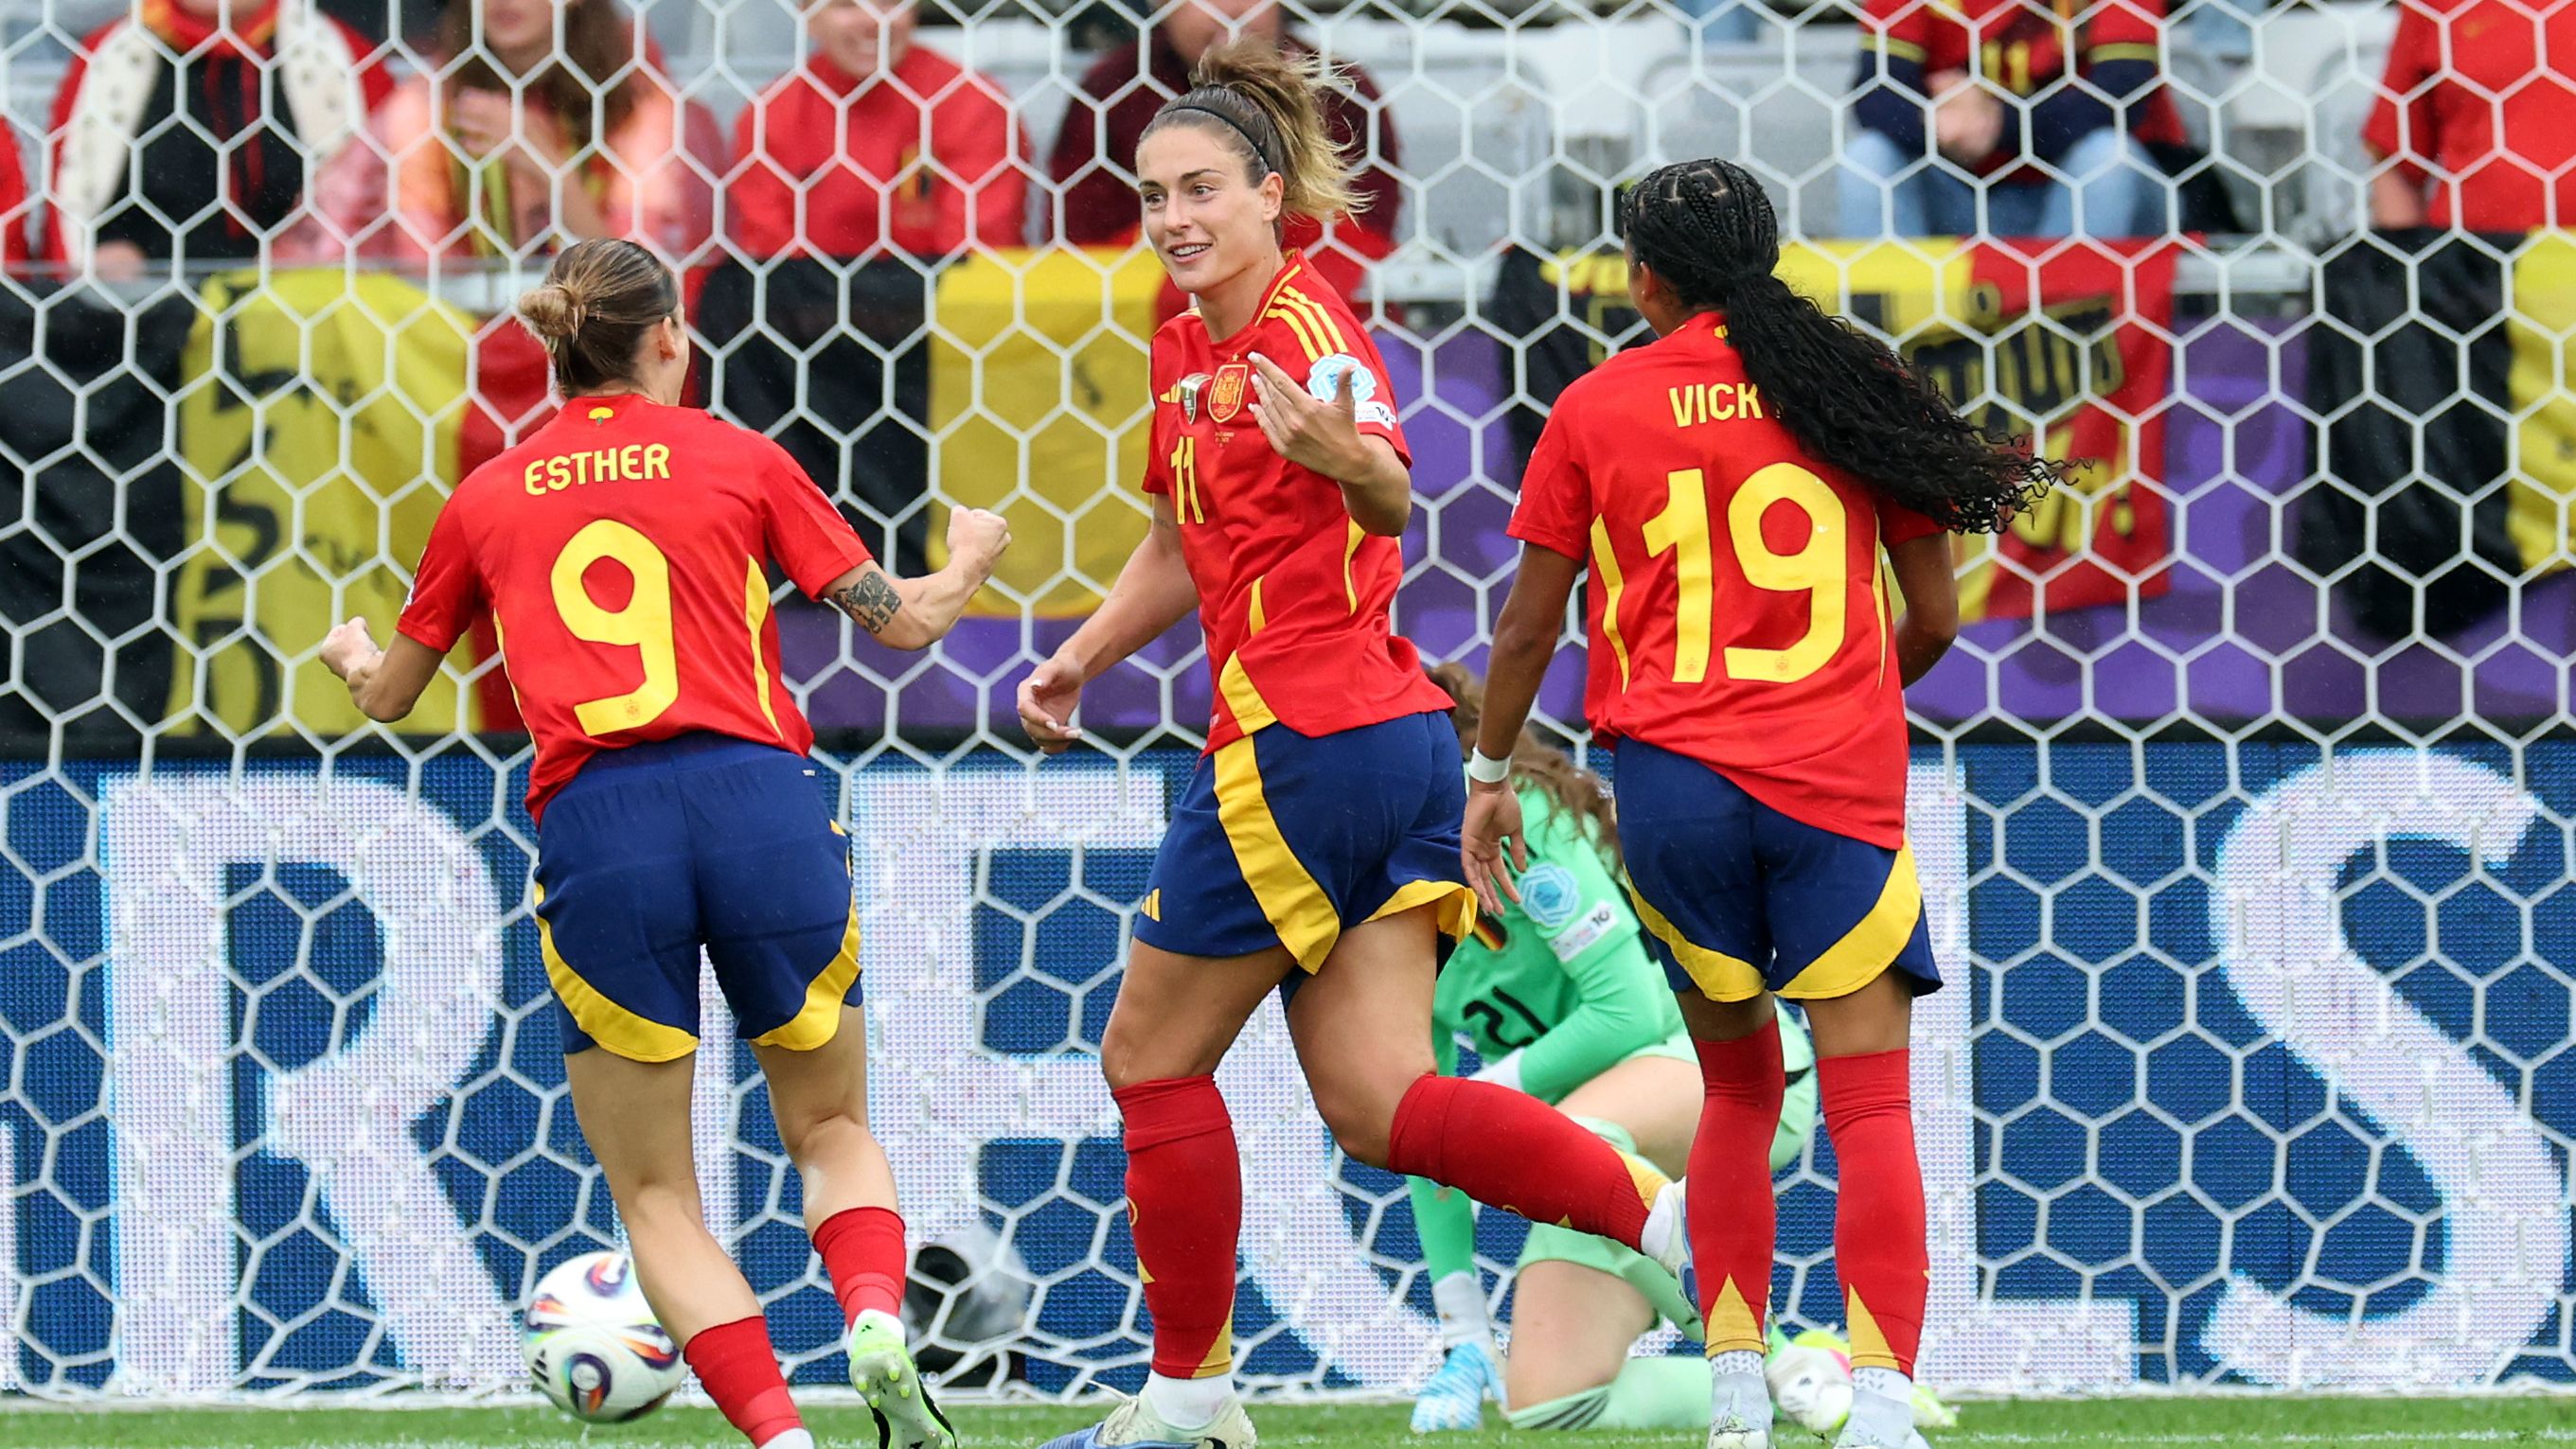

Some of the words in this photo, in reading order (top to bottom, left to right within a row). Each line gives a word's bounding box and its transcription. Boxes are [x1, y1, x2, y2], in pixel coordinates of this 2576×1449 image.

[1669, 382, 1784, 428] VICK
[524, 443, 671, 496] ESTHER
[1170, 436, 1204, 524] 11
[1642, 462, 1847, 683] 19
[550, 519, 680, 737] 9
[1464, 985, 1550, 1049] 21
